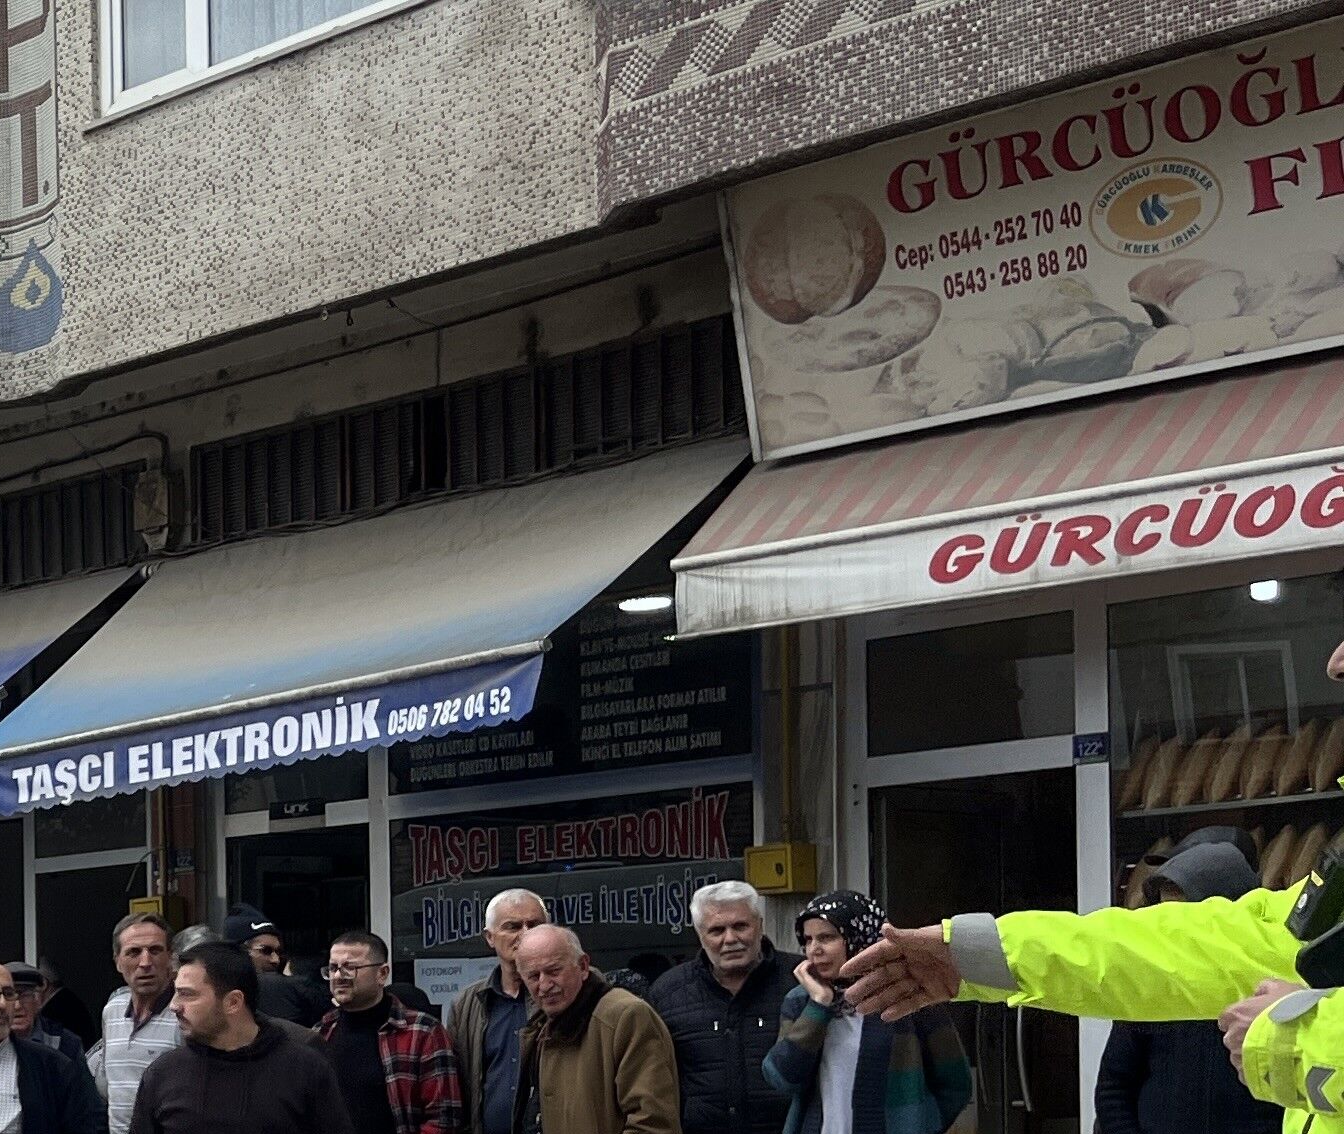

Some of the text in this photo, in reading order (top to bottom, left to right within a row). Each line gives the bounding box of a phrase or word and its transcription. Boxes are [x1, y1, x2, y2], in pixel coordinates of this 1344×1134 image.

[886, 46, 1344, 213] GÜRCÜOĞL
[895, 244, 934, 271] Cep:
[1031, 209, 1055, 239] 70
[1059, 201, 1082, 231] 40
[1037, 250, 1060, 279] 88
[1065, 244, 1088, 273] 20
[12, 685, 512, 806] TAŞCI ELEKTRONİK 0506 782 04 52
[408, 789, 730, 886] TAŞCI ELEKTRONİK
[563, 894, 593, 926] VE
[599, 868, 718, 934] İLETİŞİ
